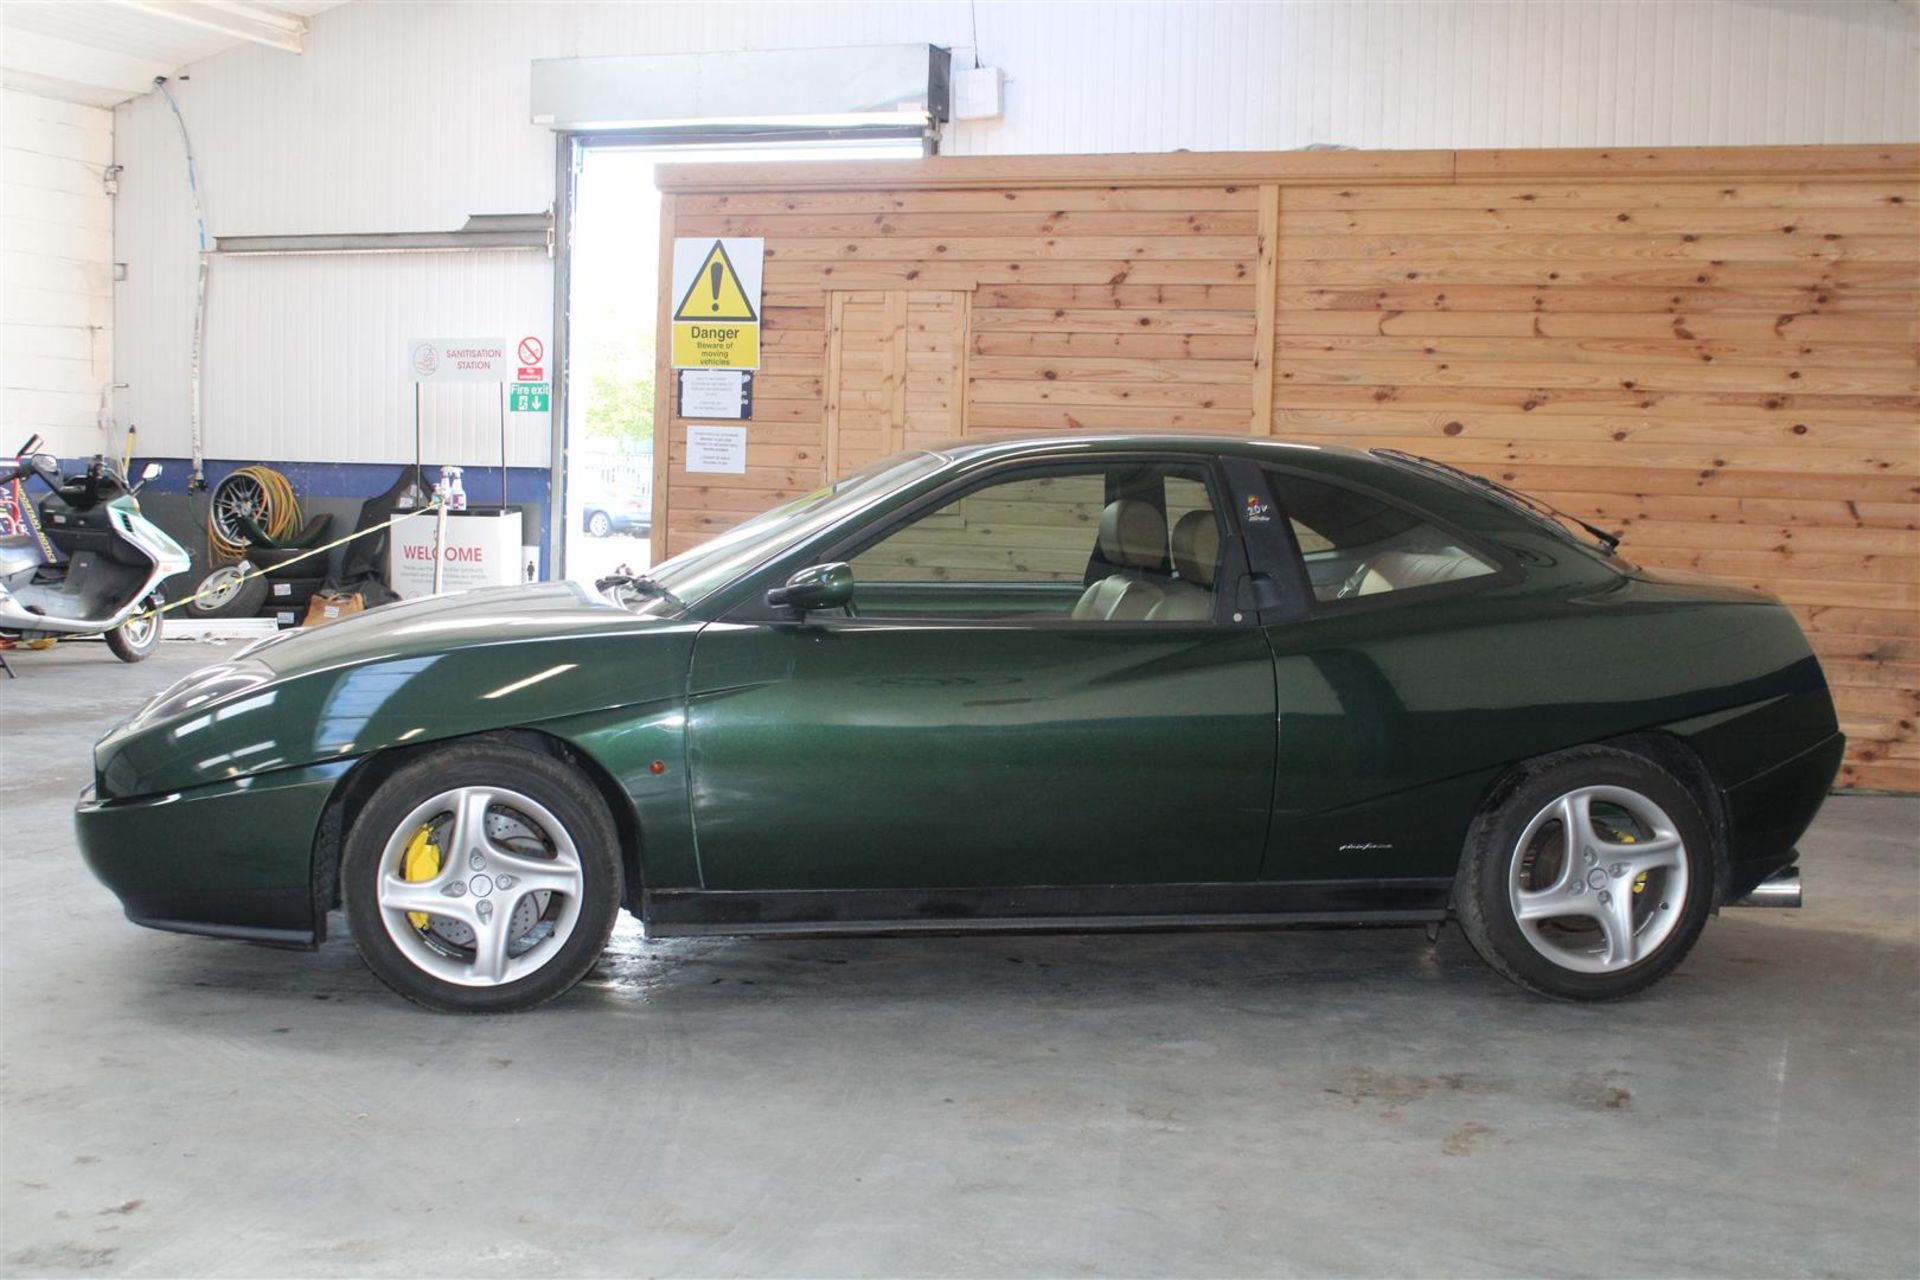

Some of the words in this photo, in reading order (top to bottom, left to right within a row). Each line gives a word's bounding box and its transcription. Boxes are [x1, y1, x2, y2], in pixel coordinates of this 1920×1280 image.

[691, 326, 740, 342] Danger
[697, 342, 724, 350] Beware
[725, 341, 734, 350] of
[446, 349, 501, 358] SANITISATION
[701, 350, 729, 359] moving
[456, 361, 491, 370] STATION
[511, 384, 529, 395] Fire
[531, 384, 549, 395] exit
